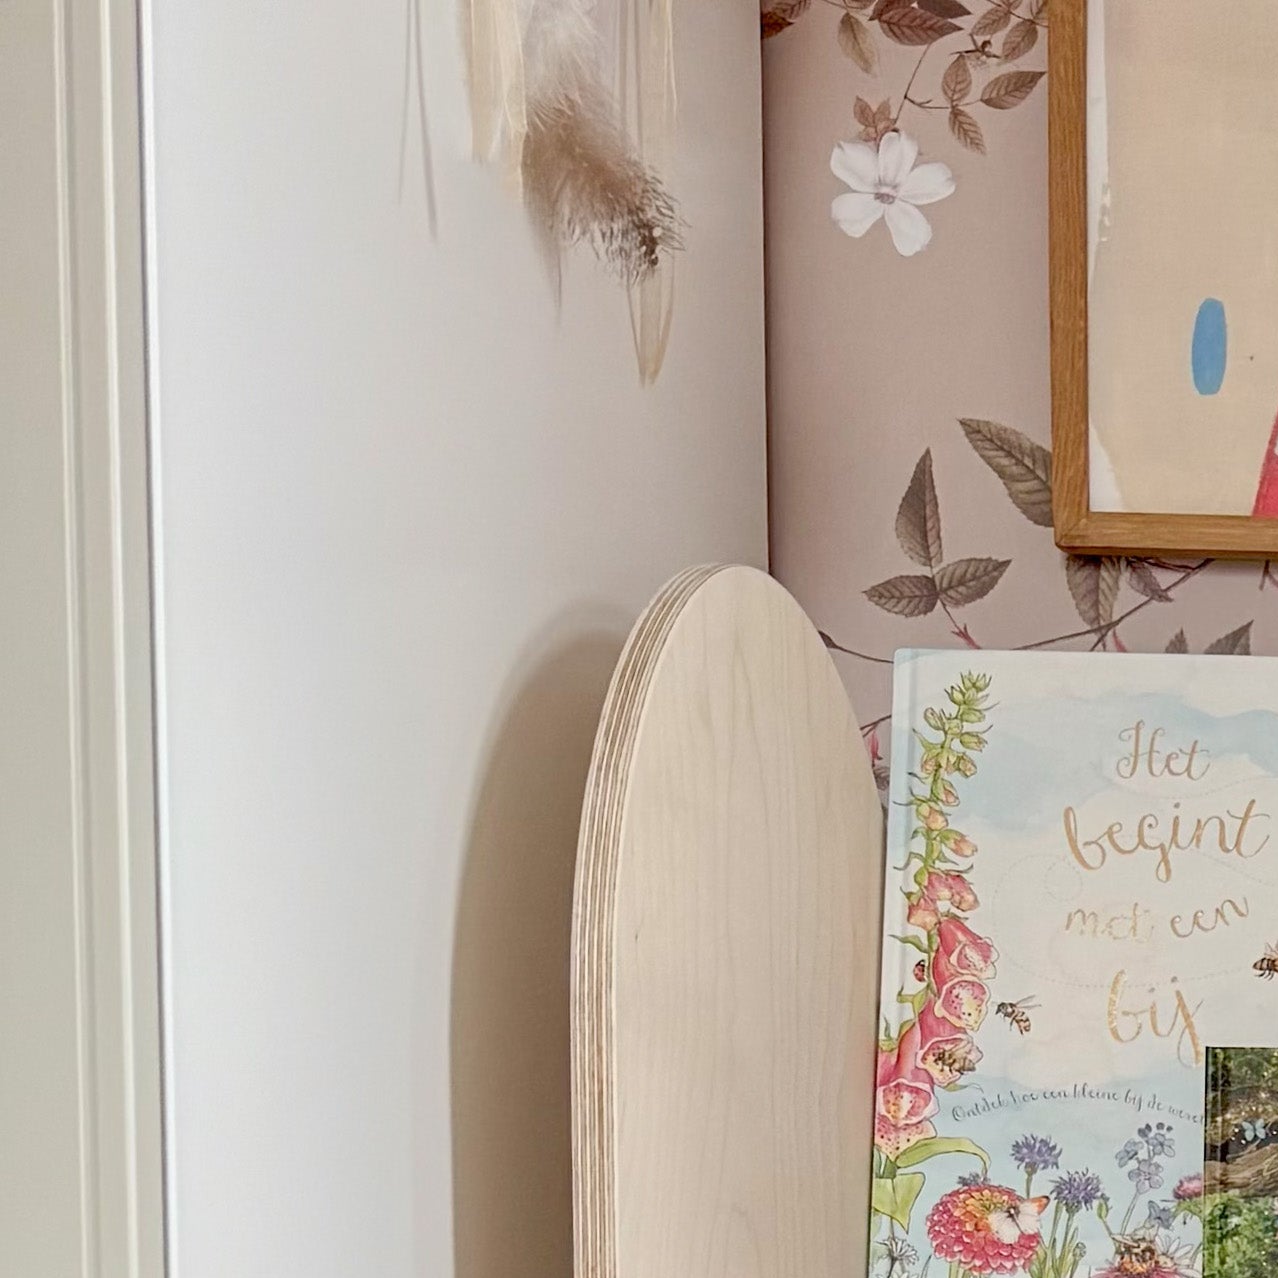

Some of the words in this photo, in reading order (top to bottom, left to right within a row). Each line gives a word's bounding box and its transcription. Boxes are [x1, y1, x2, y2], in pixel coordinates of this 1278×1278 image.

[1116, 719, 1210, 781] Het
[1063, 799, 1270, 883] begint
[1065, 902, 1153, 943] met
[1170, 896, 1249, 938] een
[1107, 968, 1204, 1069] bij
[1042, 1088, 1069, 1100] een
[1073, 1082, 1120, 1101] kleine
[1124, 1089, 1143, 1112] bij
[1147, 1093, 1163, 1112] de
